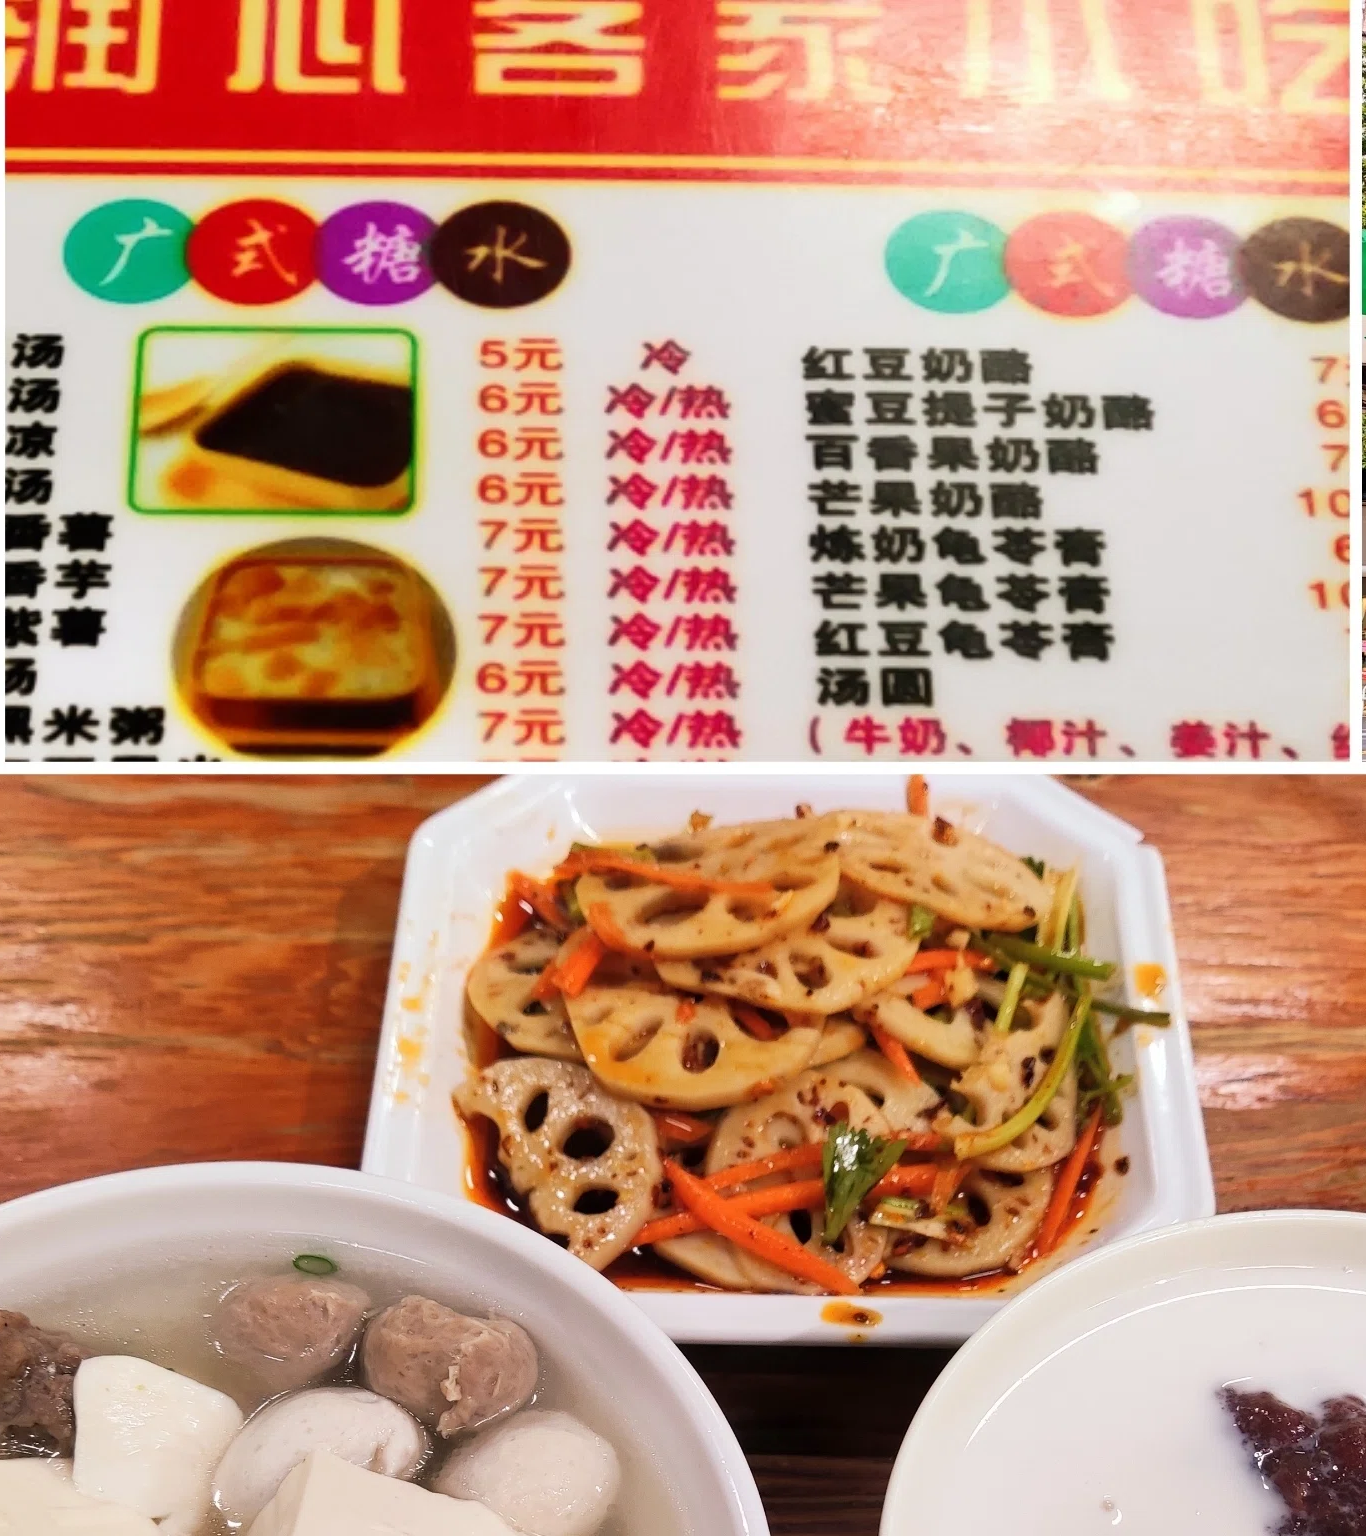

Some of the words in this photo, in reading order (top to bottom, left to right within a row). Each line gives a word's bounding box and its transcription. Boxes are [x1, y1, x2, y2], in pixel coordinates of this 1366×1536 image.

[100, 215, 547, 287] 广式糖水
[480, 339, 564, 371] 5元
[640, 340, 692, 375] 冷
[802, 347, 1034, 386] 红豆奶酪
[480, 384, 564, 415] 6元
[605, 382, 731, 420] 冷/热
[480, 430, 564, 461] 6元
[605, 427, 733, 466] 冷/热
[807, 435, 1100, 476] 百香果奶酪
[480, 475, 564, 507] 6元
[605, 473, 735, 512] 冷/热
[809, 481, 1044, 520] 芒果奶酪
[480, 521, 564, 553] 7元
[607, 519, 736, 559] 冷/热
[480, 568, 564, 601] 7元
[607, 566, 738, 606] 冷/热
[480, 615, 564, 648] 7元
[607, 613, 739, 654] 冷/热
[814, 620, 1115, 662] 红豆龟苓膏
[480, 663, 564, 697] 6元
[609, 661, 741, 701] 冷/热
[817, 667, 936, 708] 汤圆
[480, 709, 564, 747] 7元
[609, 707, 743, 750] 冷/热
